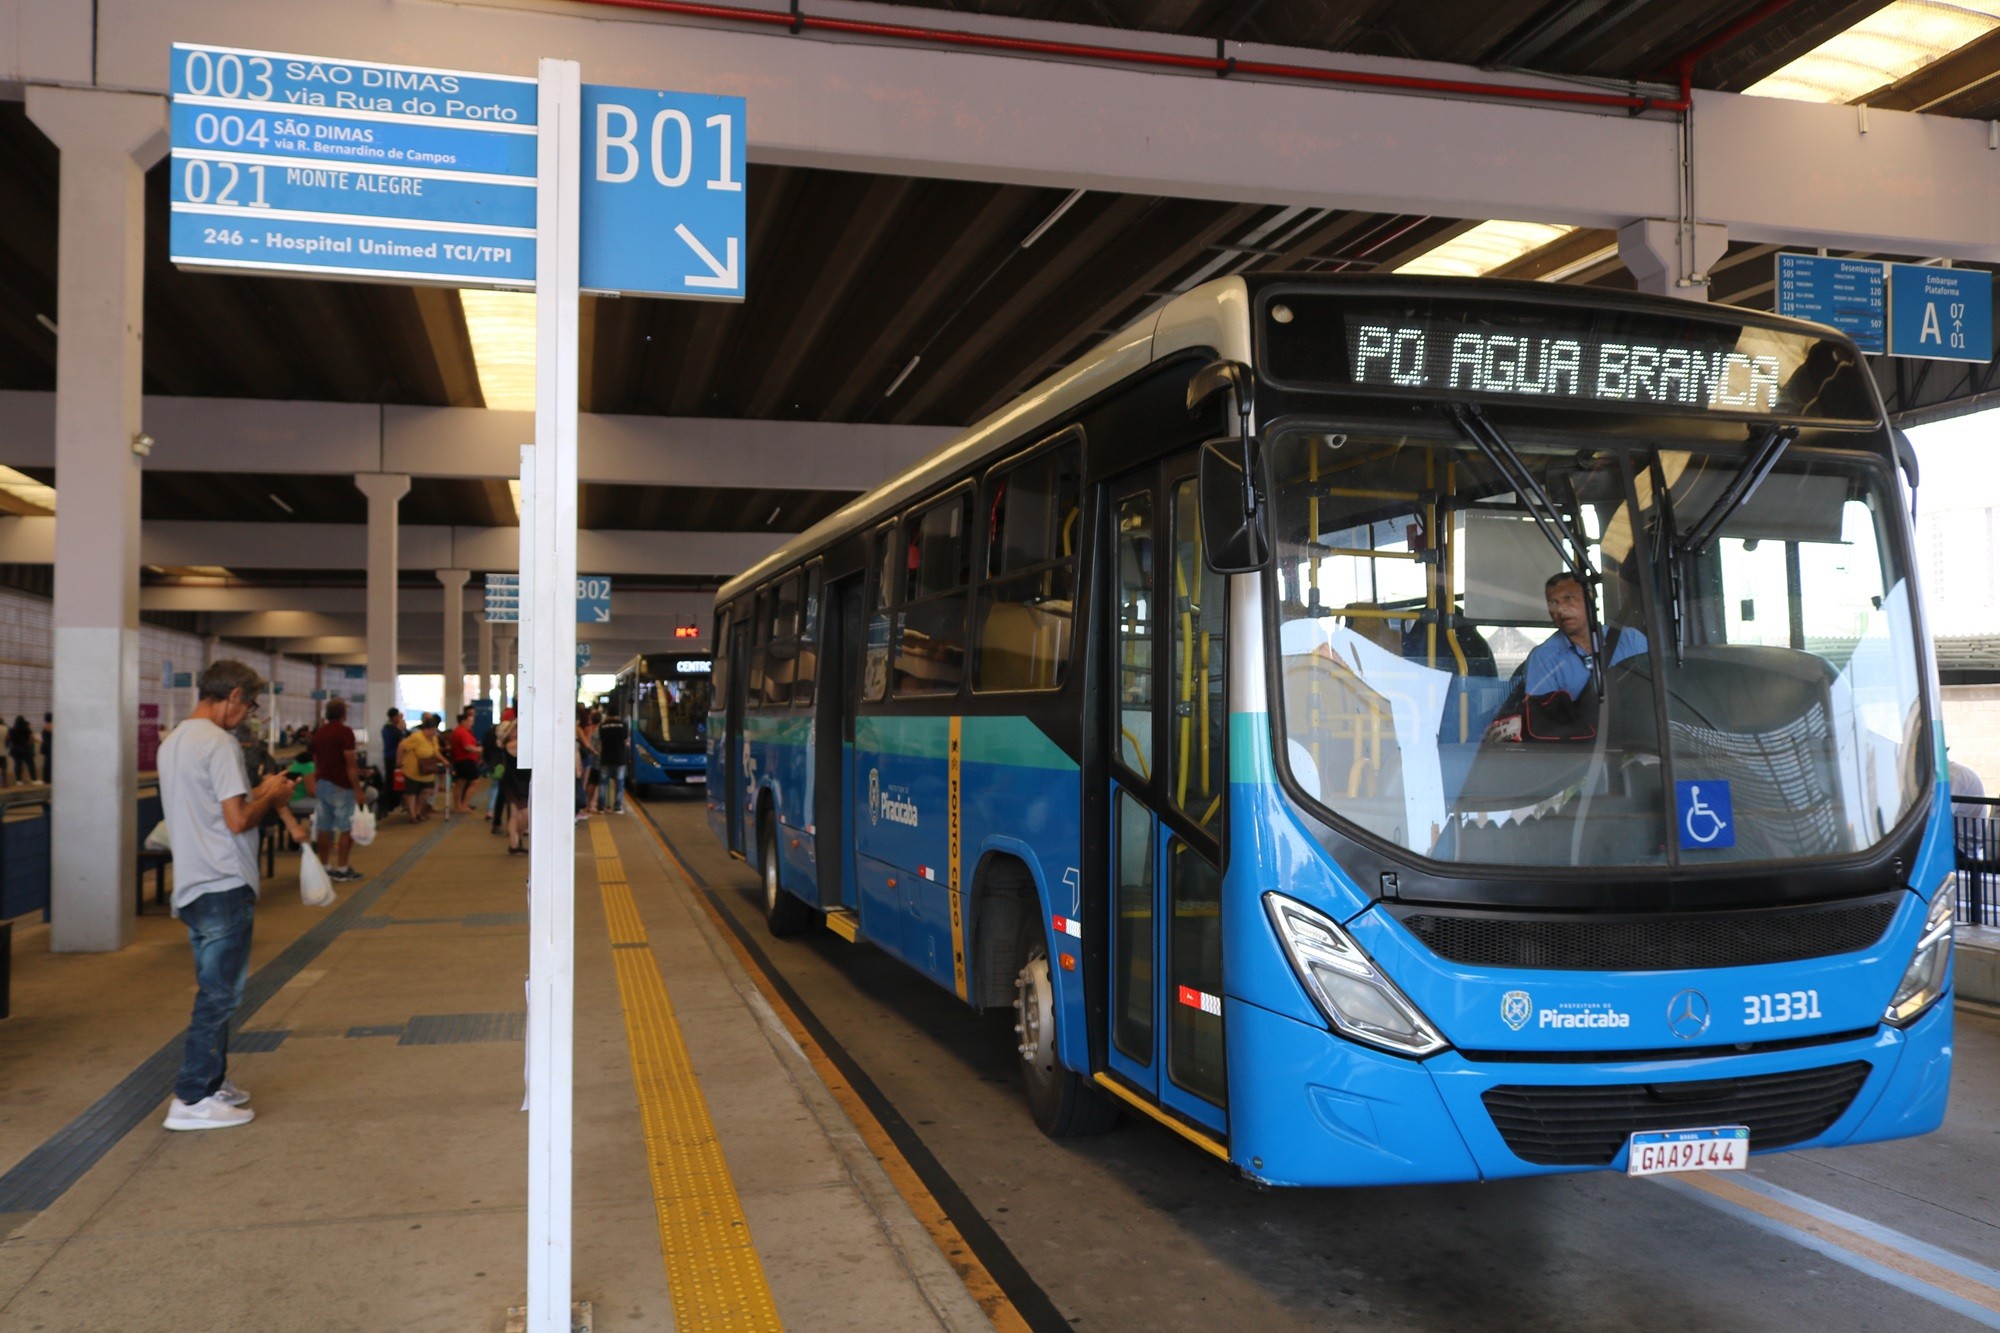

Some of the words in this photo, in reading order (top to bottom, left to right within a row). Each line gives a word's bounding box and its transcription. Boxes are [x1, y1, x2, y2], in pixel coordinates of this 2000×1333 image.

[185, 51, 273, 101] 003
[286, 62, 353, 84] SÃO
[363, 69, 460, 94] DIMAS
[285, 88, 326, 106] via
[336, 91, 393, 112] Rua
[401, 97, 436, 115] do
[446, 99, 518, 121] Porto
[195, 113, 270, 149] 004
[274, 119, 310, 137] SÃO
[315, 124, 374, 143] DIMAS
[274, 139, 295, 150] via
[297, 140, 310, 151] R.
[313, 141, 385, 158] Bernardino
[387, 147, 404, 159] de
[406, 150, 457, 165] Campos
[596, 103, 742, 191] B01
[184, 159, 271, 209] 021
[287, 168, 349, 190] MONTE
[355, 174, 424, 197] ALEGRE
[204, 228, 244, 246] 246
[266, 232, 352, 254] Hospital
[358, 238, 437, 259] Unimed
[443, 244, 512, 263] TCI/TPI
[1783, 258, 1794, 267] 503
[1783, 269, 1794, 278] 505
[1840, 262, 1881, 275] Desembarque
[1783, 280, 1794, 289] 501
[1870, 287, 1881, 296] 120
[1924, 285, 1959, 296] Plataforma
[1926, 275, 1958, 286] Embarque
[1783, 291, 1794, 300] 123
[1783, 302, 1794, 311] 119
[1870, 298, 1881, 307] 126
[1920, 302, 1942, 344] A
[1950, 303, 1965, 319] 07
[1870, 319, 1881, 328] 507
[1950, 332, 1965, 348] 01
[1450, 333, 1581, 395] AGUA
[1597, 344, 1780, 408] BRANCA
[576, 580, 610, 599] B02
[881, 792, 918, 827] Piracicaba
[951, 867, 959, 927] CEGO
[1539, 1009, 1630, 1028] Piracicaba
[1743, 989, 1822, 1025] 31331
[1641, 1142, 1734, 1171] GAA9I44
